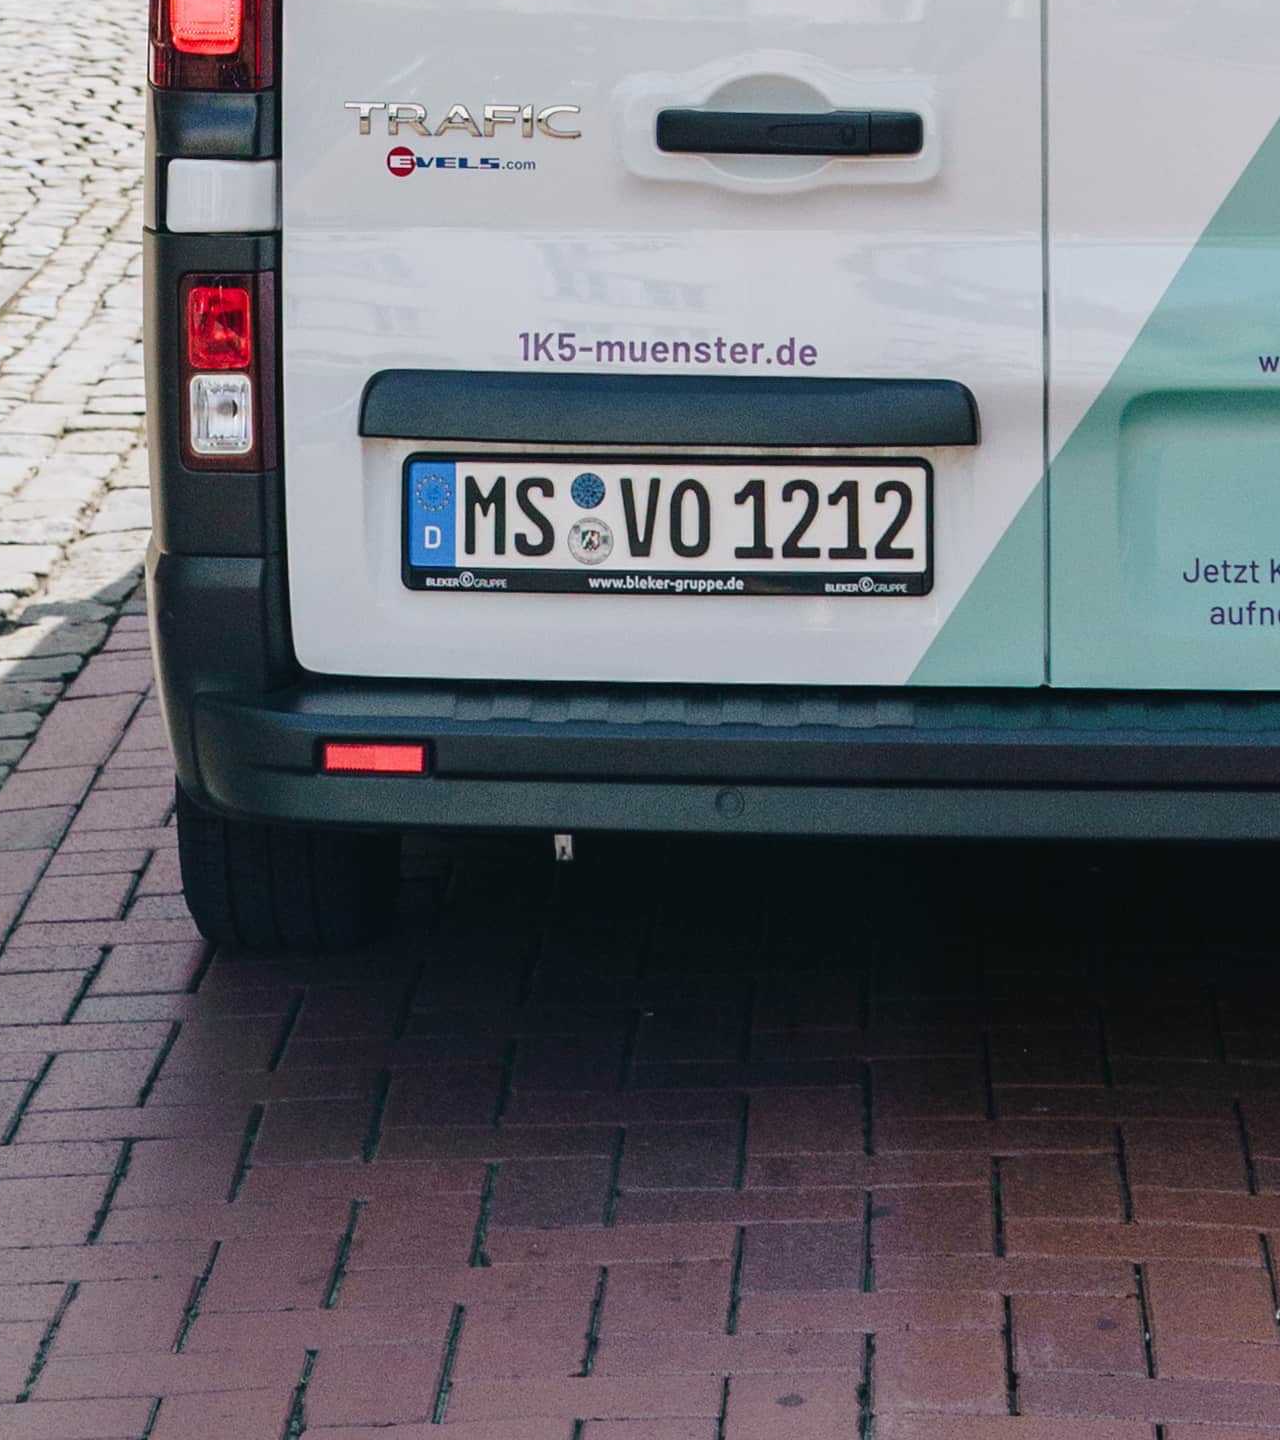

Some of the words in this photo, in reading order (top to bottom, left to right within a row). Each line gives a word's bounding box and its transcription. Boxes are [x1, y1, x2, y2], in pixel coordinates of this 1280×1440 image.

[344, 101, 582, 139] TRAFIC
[519, 332, 818, 366] 1K5-muenster.de
[424, 525, 441, 549] D
[464, 475, 555, 557] MS
[620, 477, 711, 558] VO
[734, 479, 915, 560] 1212
[588, 574, 745, 593] www.bleker-gruppe.de
[1183, 558, 1260, 584] Jetzt
